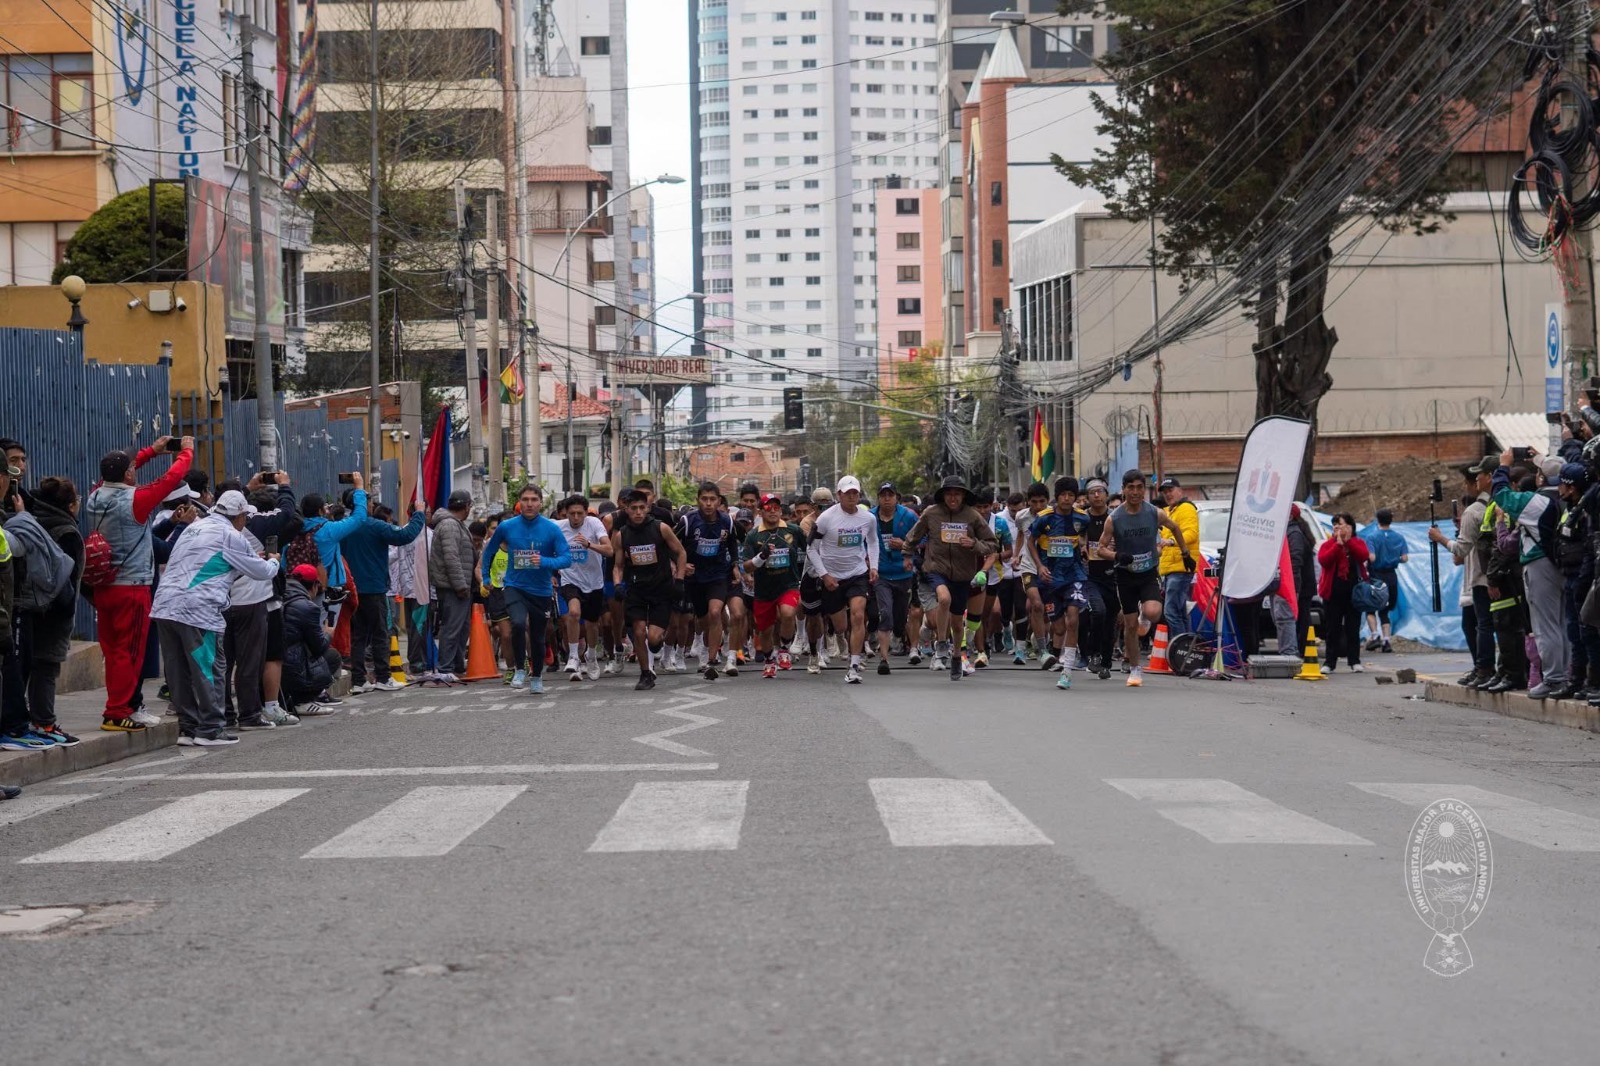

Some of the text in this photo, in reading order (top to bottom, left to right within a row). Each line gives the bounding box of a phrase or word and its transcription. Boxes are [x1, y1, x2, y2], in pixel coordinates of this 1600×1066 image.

[682, 358, 707, 374] REAL
[842, 536, 859, 544] 598
[701, 546, 716, 554] 195
[1051, 546, 1070, 554] 593
[517, 557, 532, 566] 45
[635, 554, 654, 562] 383
[1132, 561, 1150, 571] 924
[1176, 649, 1204, 661] MYAPS
